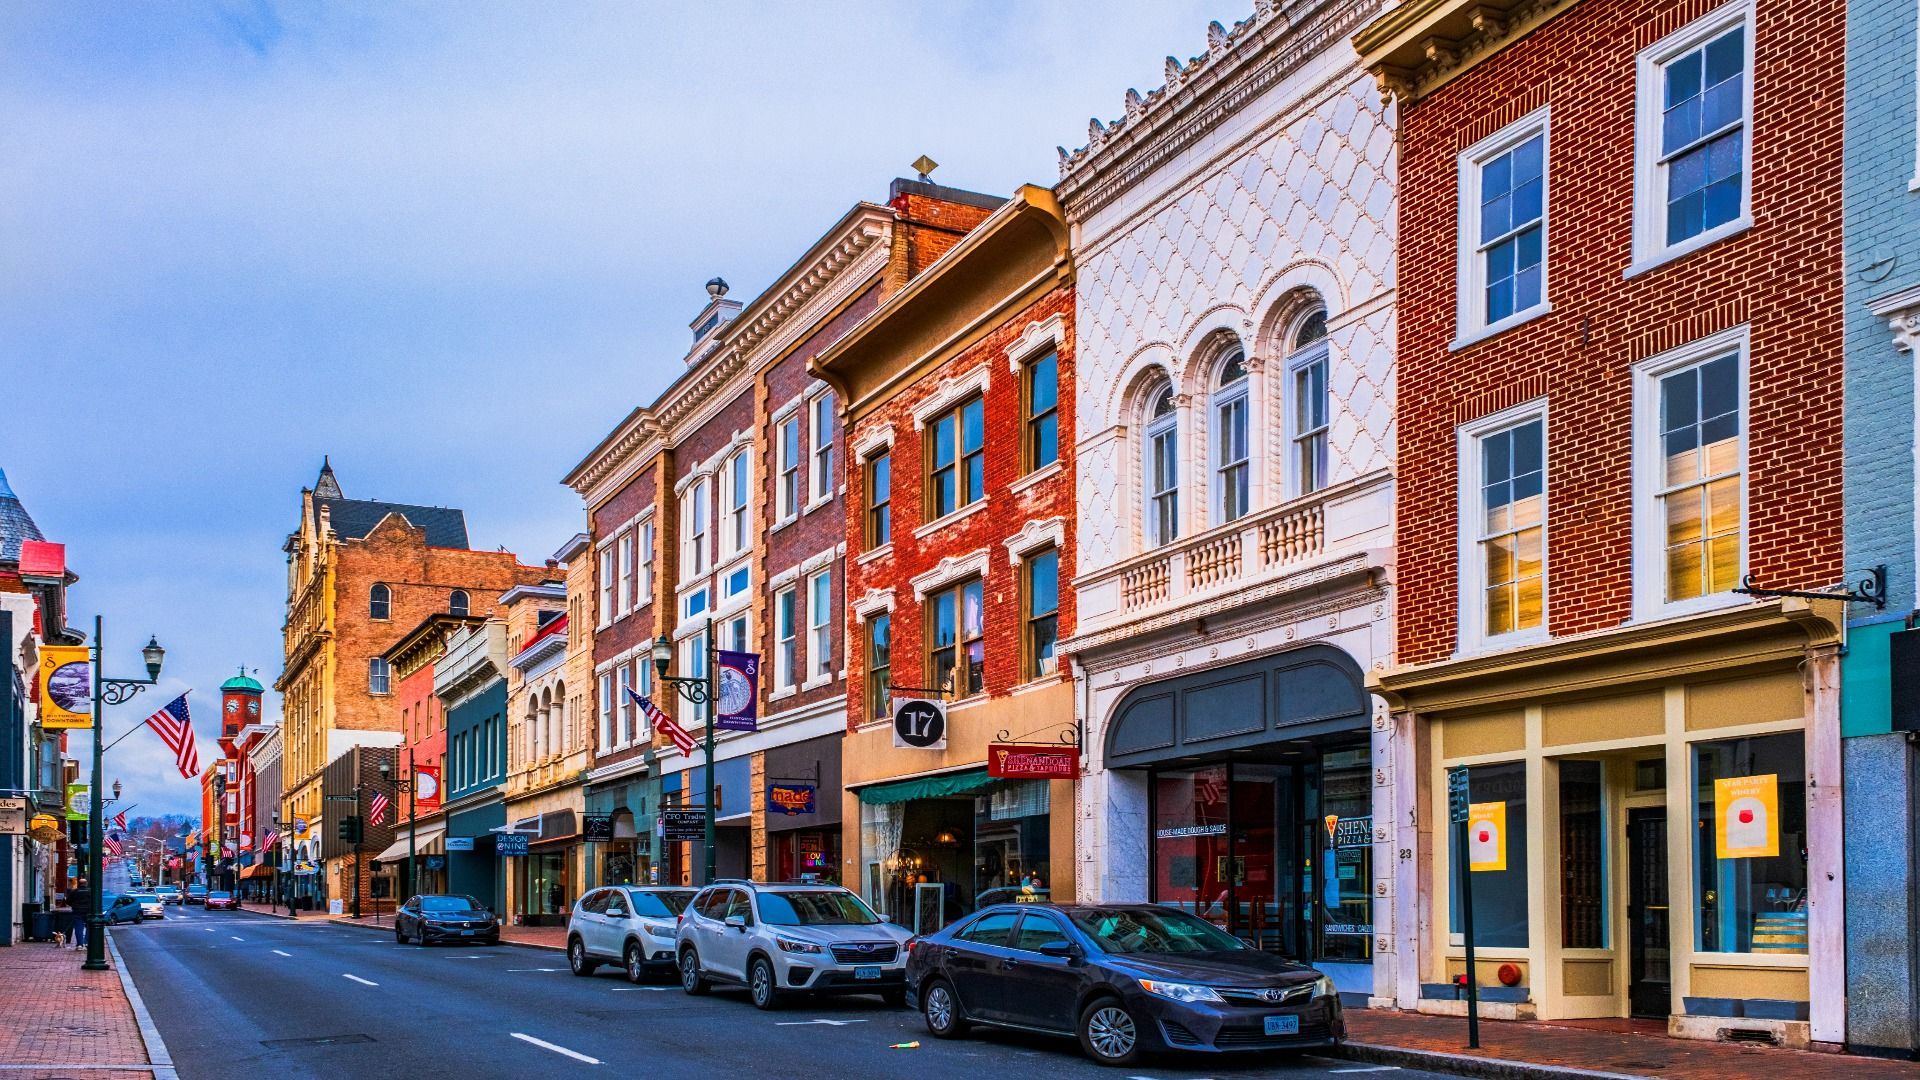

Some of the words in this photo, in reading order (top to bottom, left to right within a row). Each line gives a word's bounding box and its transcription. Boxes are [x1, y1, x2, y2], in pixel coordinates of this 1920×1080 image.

[904, 710, 935, 738] 17
[1007, 754, 1072, 767] SHENANDOAH
[1730, 787, 1761, 796] WINERY
[1187, 826, 1204, 834] DOUGH
[1209, 823, 1227, 832] SAUCE
[497, 835, 528, 843] DESIGN
[1338, 835, 1362, 844] PIZZA
[1363, 834, 1372, 844] &
[1399, 848, 1412, 860] 23
[1325, 924, 1355, 933] SANDWICHES
